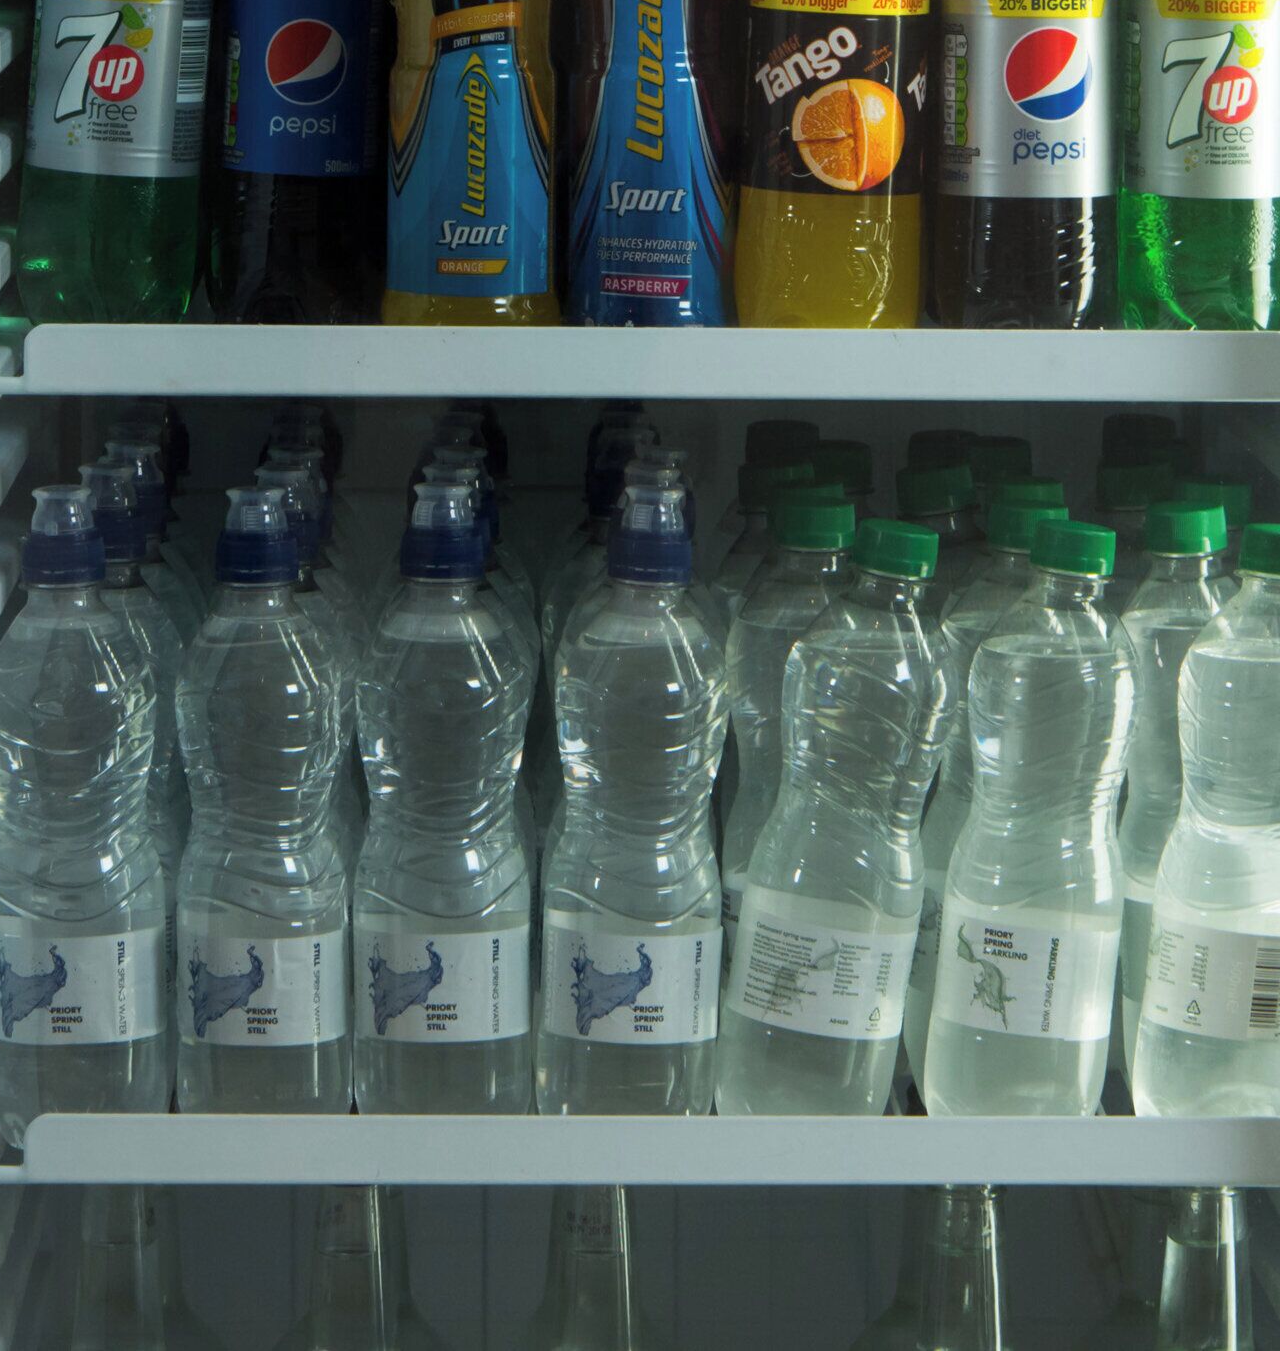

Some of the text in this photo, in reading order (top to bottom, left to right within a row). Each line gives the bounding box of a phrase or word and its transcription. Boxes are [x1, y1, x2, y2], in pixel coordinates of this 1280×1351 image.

[54, 10, 138, 124] 7 up
[755, 25, 859, 106] Tango
[1161, 31, 1252, 149] 7 up
[88, 97, 138, 123] free
[270, 114, 337, 139] pepsi
[1204, 122, 1254, 143] free
[1013, 128, 1041, 141] diet
[461, 76, 490, 218] Lucozade
[1013, 137, 1086, 165] pepsi
[605, 181, 688, 216] Sport
[437, 219, 511, 249] Sport
[598, 237, 698, 251] ENHANCES HYDRATION
[597, 250, 692, 265] FUELS PERFORMANCE
[441, 260, 485, 273] ORANGE
[604, 277, 680, 293] RASPBERRY
[984, 927, 1013, 939] PRIORY
[984, 937, 1013, 949] SPRING
[117, 940, 126, 966] STILL
[312, 942, 321, 967] STILL
[492, 938, 500, 964] STILL
[695, 940, 703, 965] STILL
[1047, 938, 1060, 981] SPARKLING
[50, 1006, 82, 1016] PRIORY
[247, 1007, 278, 1016] PRIORY
[426, 1003, 457, 1013] PRIORY
[633, 1005, 665, 1014] PRIORY
[51, 1015, 84, 1025] SPRING
[247, 1017, 279, 1026] SPRING
[426, 1013, 458, 1022] SPRING
[633, 1014, 665, 1024] SPRING
[52, 1025, 73, 1034] STILL
[247, 1026, 267, 1035] STILL
[427, 1023, 447, 1031] STILL
[634, 1024, 654, 1033] STILL
